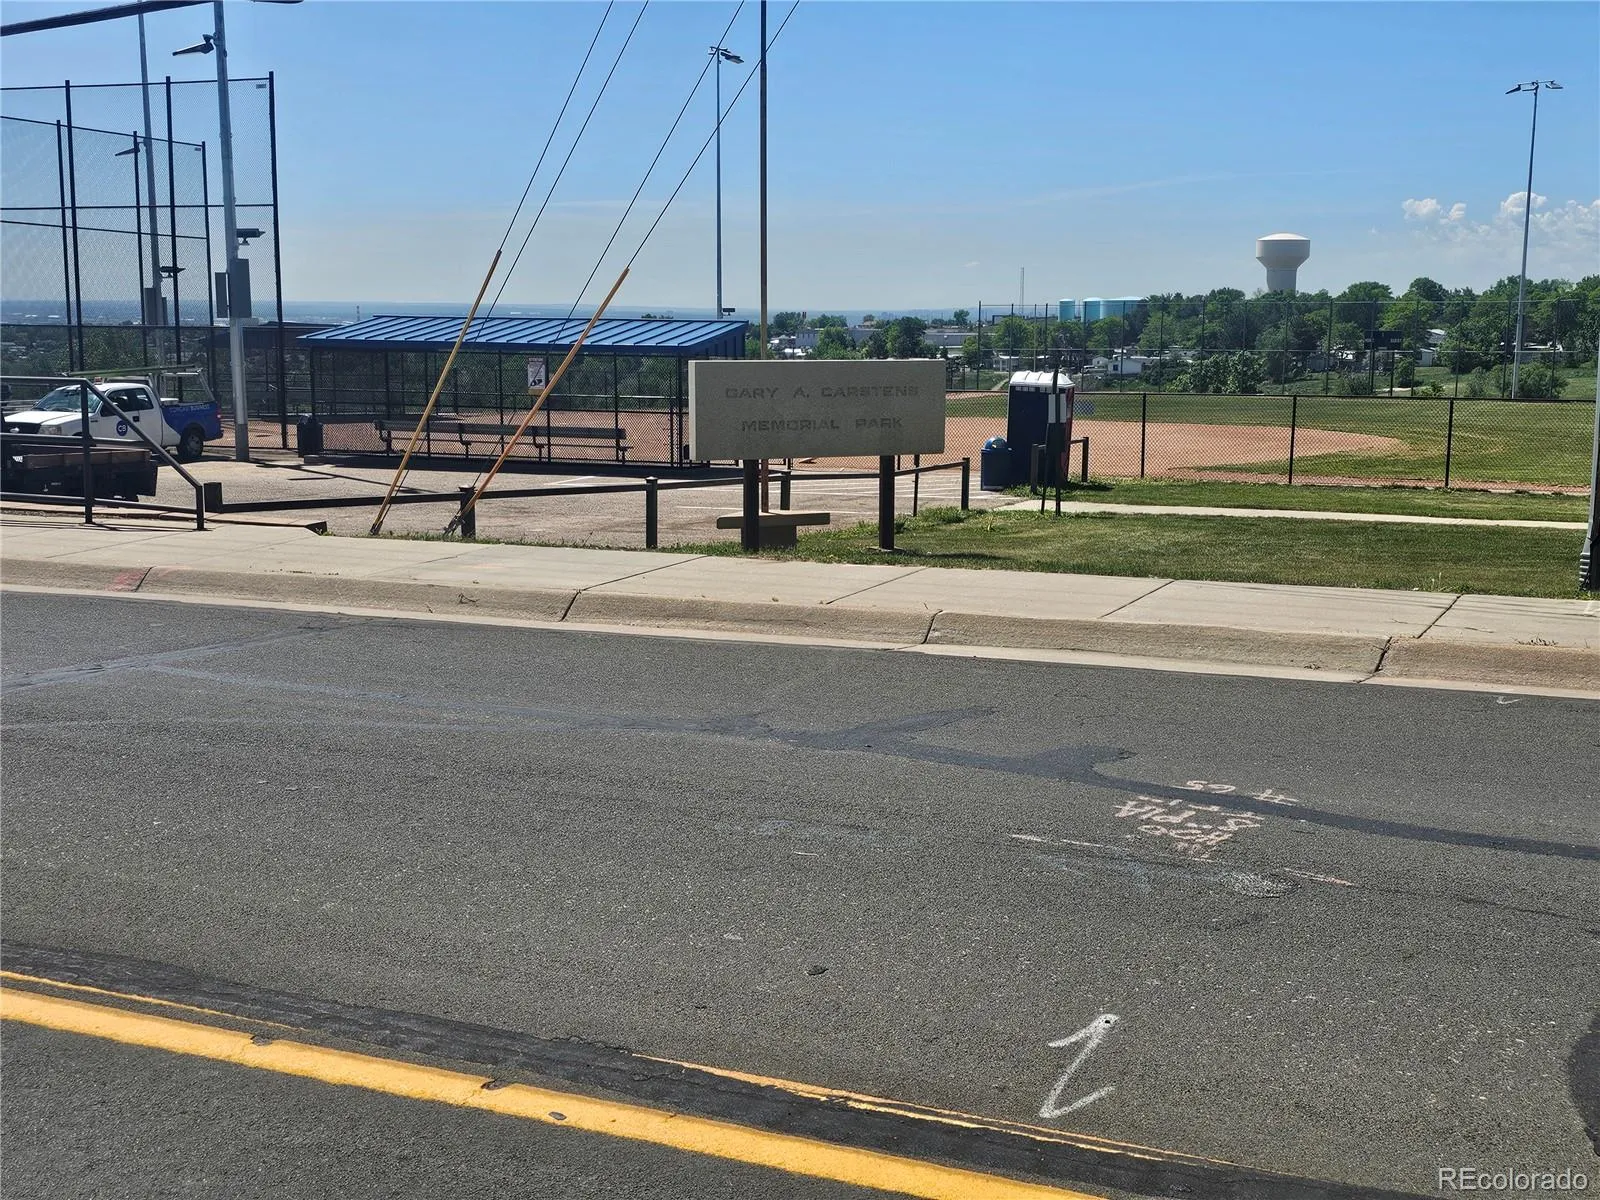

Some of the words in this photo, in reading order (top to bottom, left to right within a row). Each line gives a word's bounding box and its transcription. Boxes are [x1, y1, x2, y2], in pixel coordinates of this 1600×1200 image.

[725, 387, 778, 399] GARY
[793, 386, 810, 398] A.
[821, 385, 919, 398] CARSTENS
[742, 419, 840, 432] MEMORIAL
[855, 417, 903, 430] PARK
